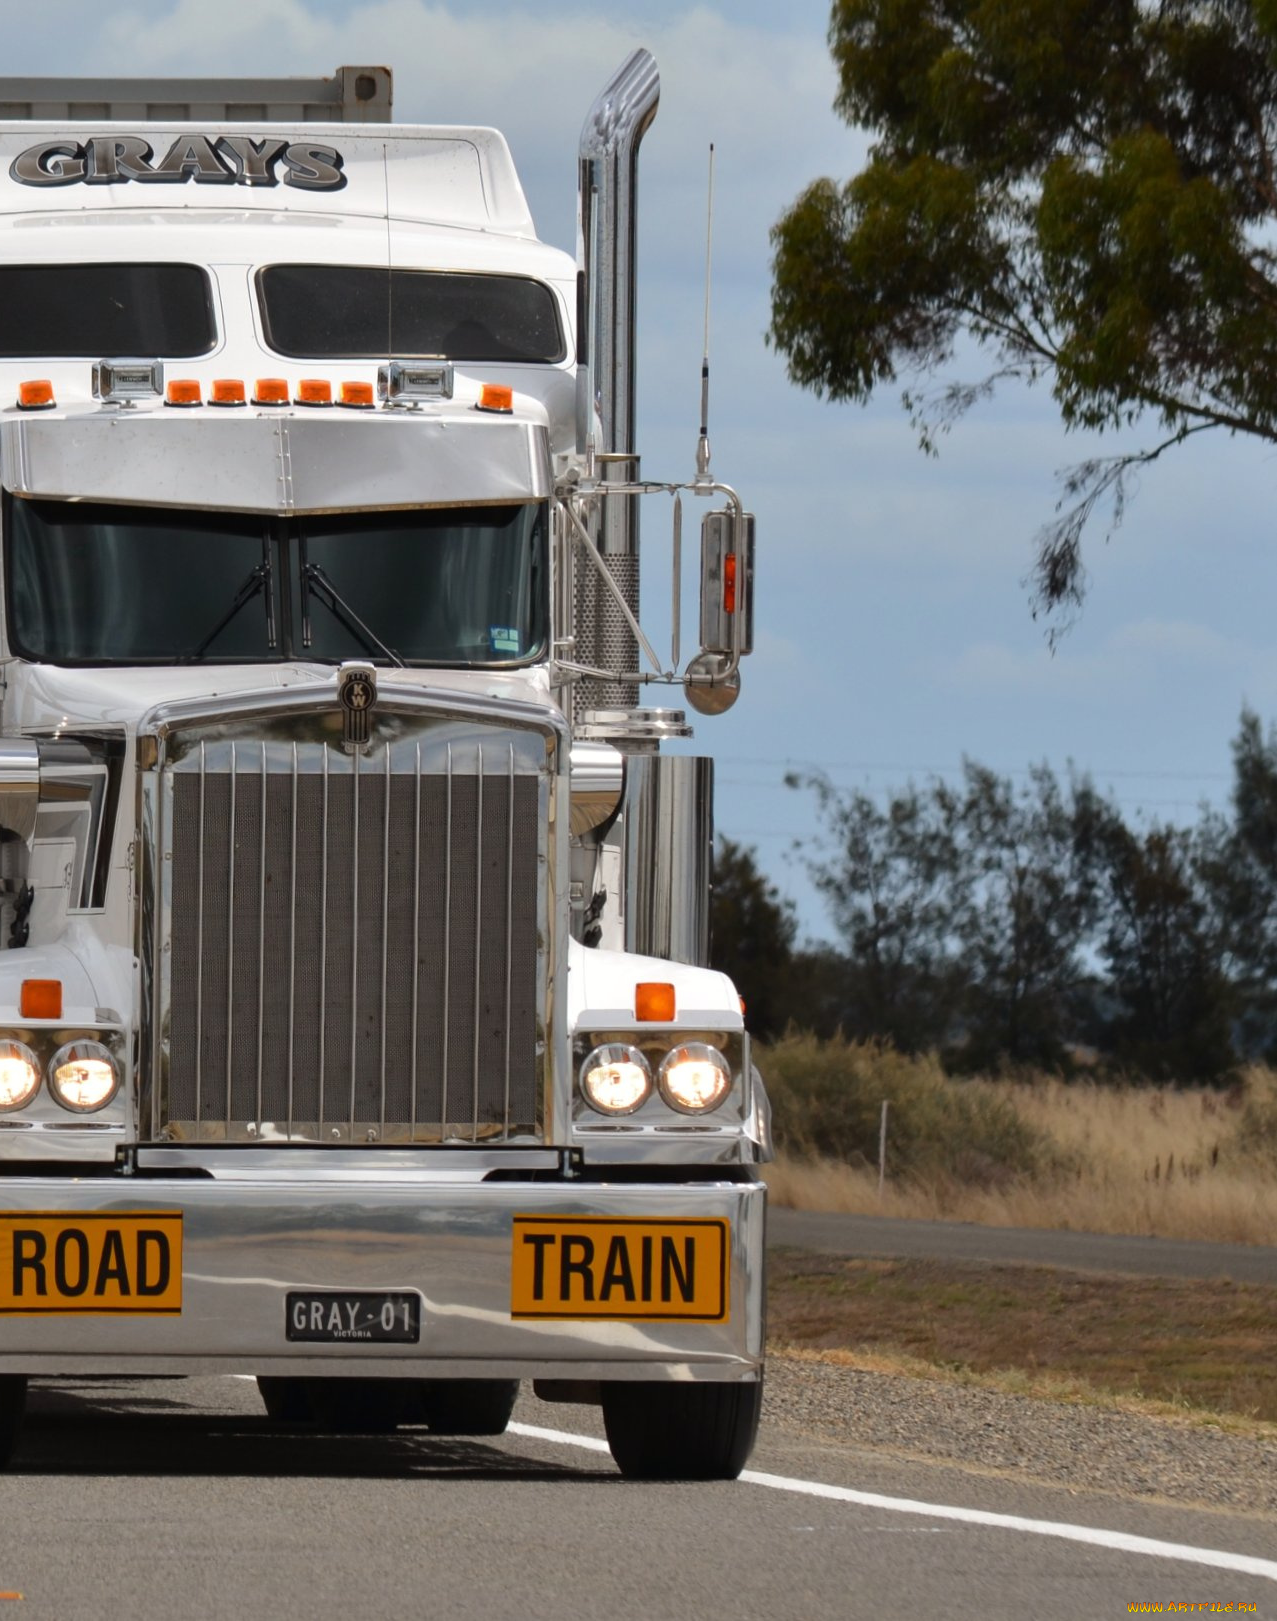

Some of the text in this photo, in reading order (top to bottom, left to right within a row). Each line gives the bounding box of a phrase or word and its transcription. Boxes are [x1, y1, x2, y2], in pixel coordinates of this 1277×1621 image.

[9, 135, 347, 192] GRAYS
[12, 1228, 695, 1303] ROAD TRAIN
[333, 1329, 372, 1338] VICTORIA
